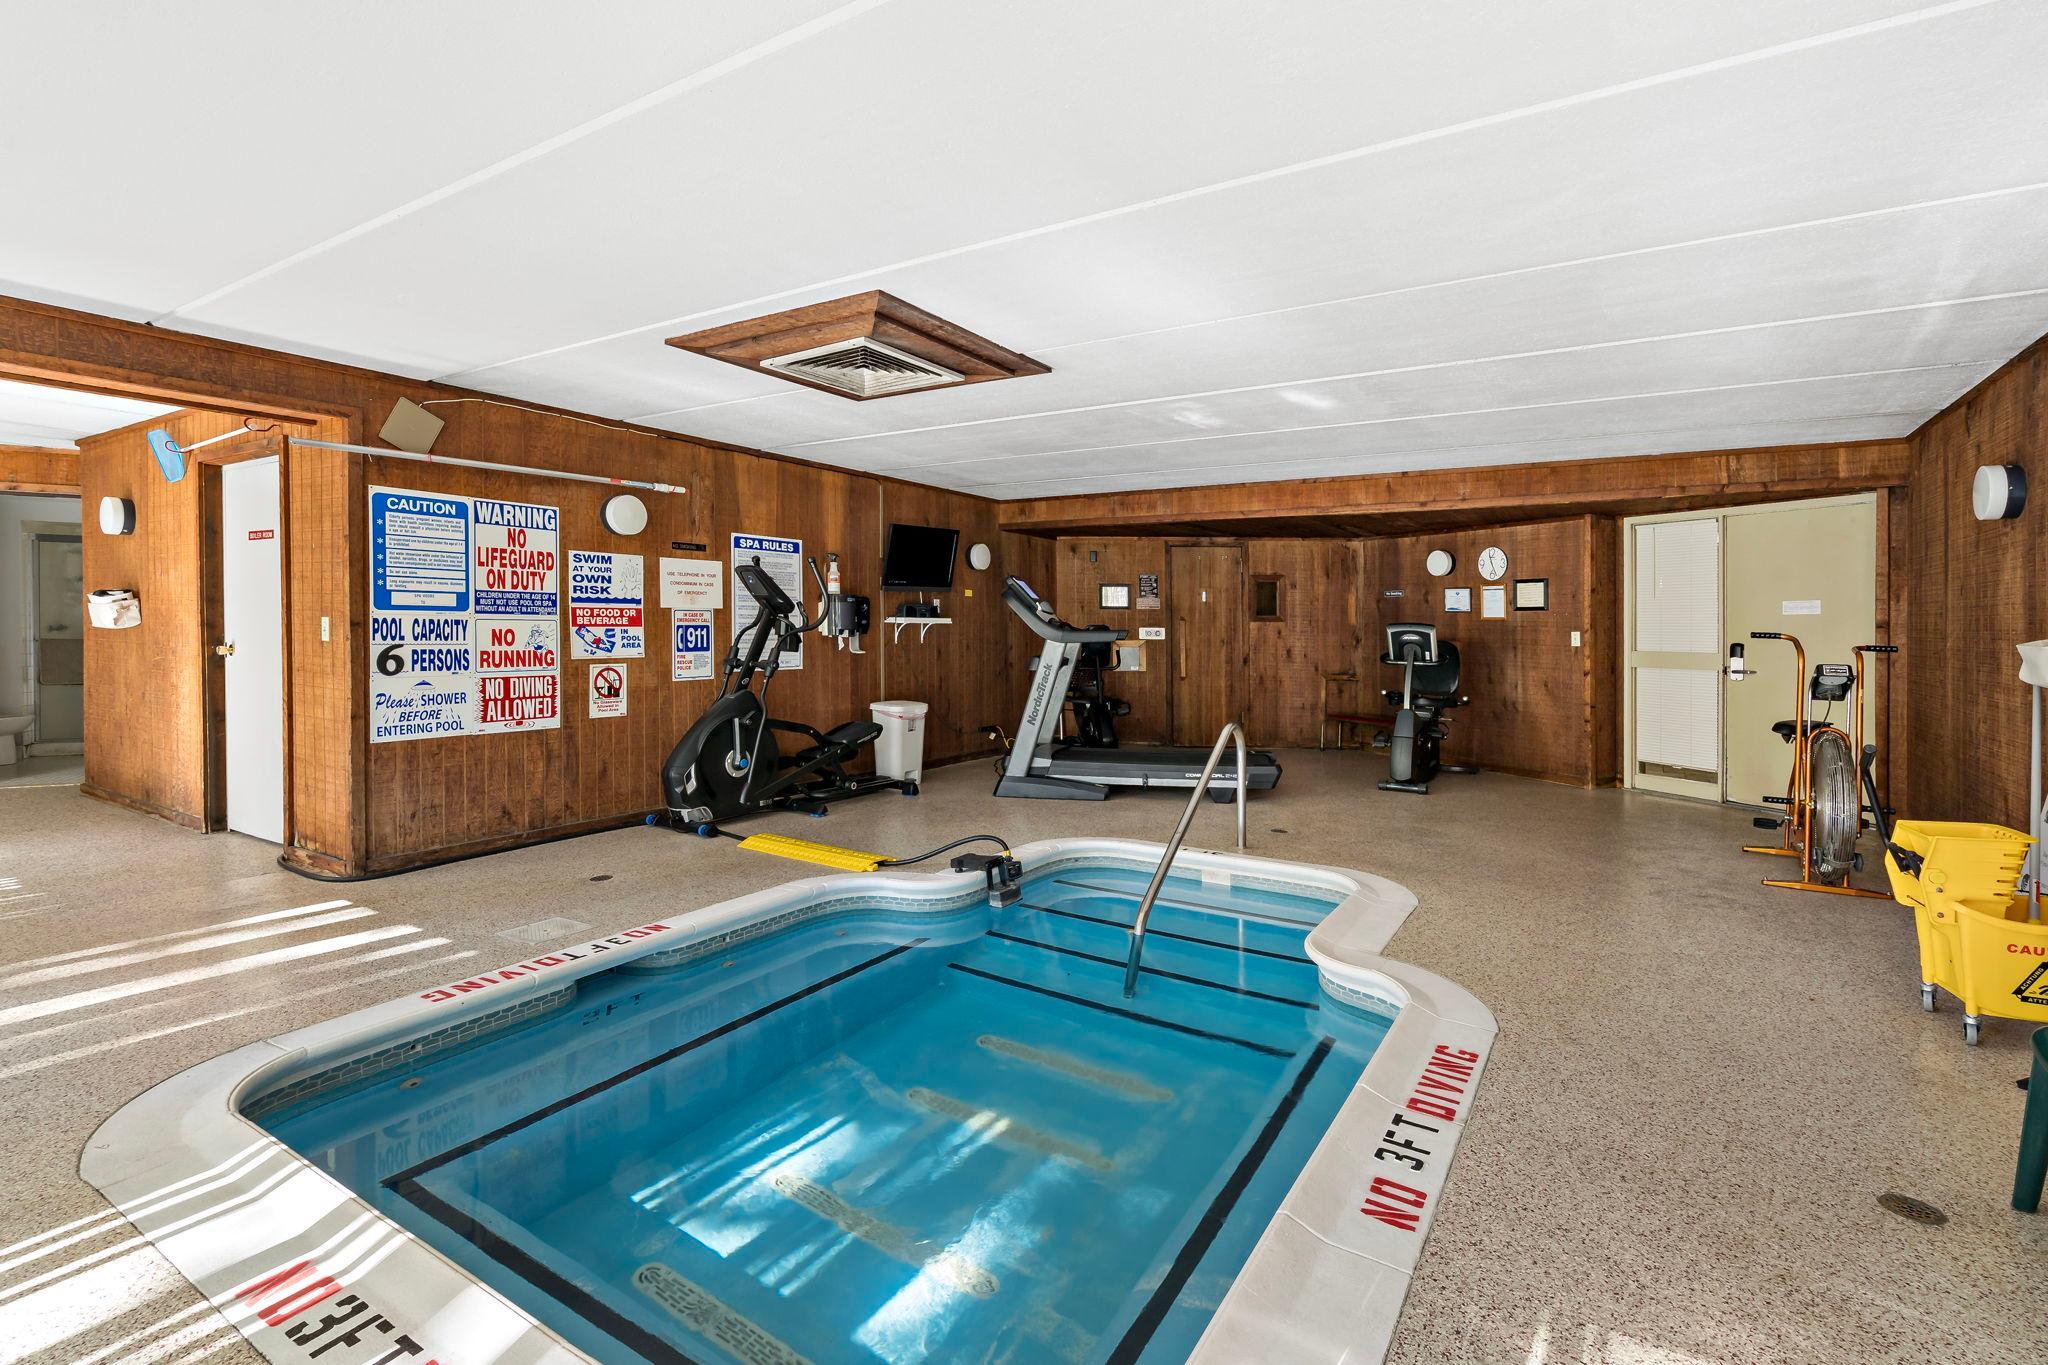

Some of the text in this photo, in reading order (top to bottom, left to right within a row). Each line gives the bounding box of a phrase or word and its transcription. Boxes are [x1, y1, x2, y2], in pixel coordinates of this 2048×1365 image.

[386, 497, 456, 516] CAUTION
[476, 501, 556, 531] WARNING
[507, 528, 527, 548] NO
[740, 538, 794, 552] SPA RULES
[477, 547, 555, 571] LIFEGUARD
[572, 553, 613, 565] SWIM
[487, 569, 512, 589] ON
[515, 571, 547, 592] DUTY
[572, 574, 612, 584] OWN
[476, 591, 503, 599] CHILDREN
[573, 585, 612, 595] RISK
[576, 608, 591, 616] NO
[623, 609, 636, 617] OR
[577, 617, 629, 625] BEVERAGE
[372, 617, 469, 642] POOL CAPACITY
[491, 628, 516, 647] NO
[687, 627, 707, 649] 911
[376, 643, 470, 677] 6 PERSONS
[480, 649, 555, 669] RUNNING
[485, 676, 553, 700] NO DIVING
[1027, 663, 1053, 727] NordicTrack
[375, 692, 467, 710] Please SHOWER
[486, 698, 552, 721] ALLOWED
[398, 709, 443, 722] BEFORE
[376, 720, 465, 737] ENTERING POOL
[622, 923, 671, 939] NO
[420, 956, 567, 1003] DIVING
[2020, 967, 2045, 991] ACHTUNG
[1406, 1044, 1480, 1122] DIVING
[1360, 1176, 1428, 1232] NO
[235, 1260, 343, 1327] NO
